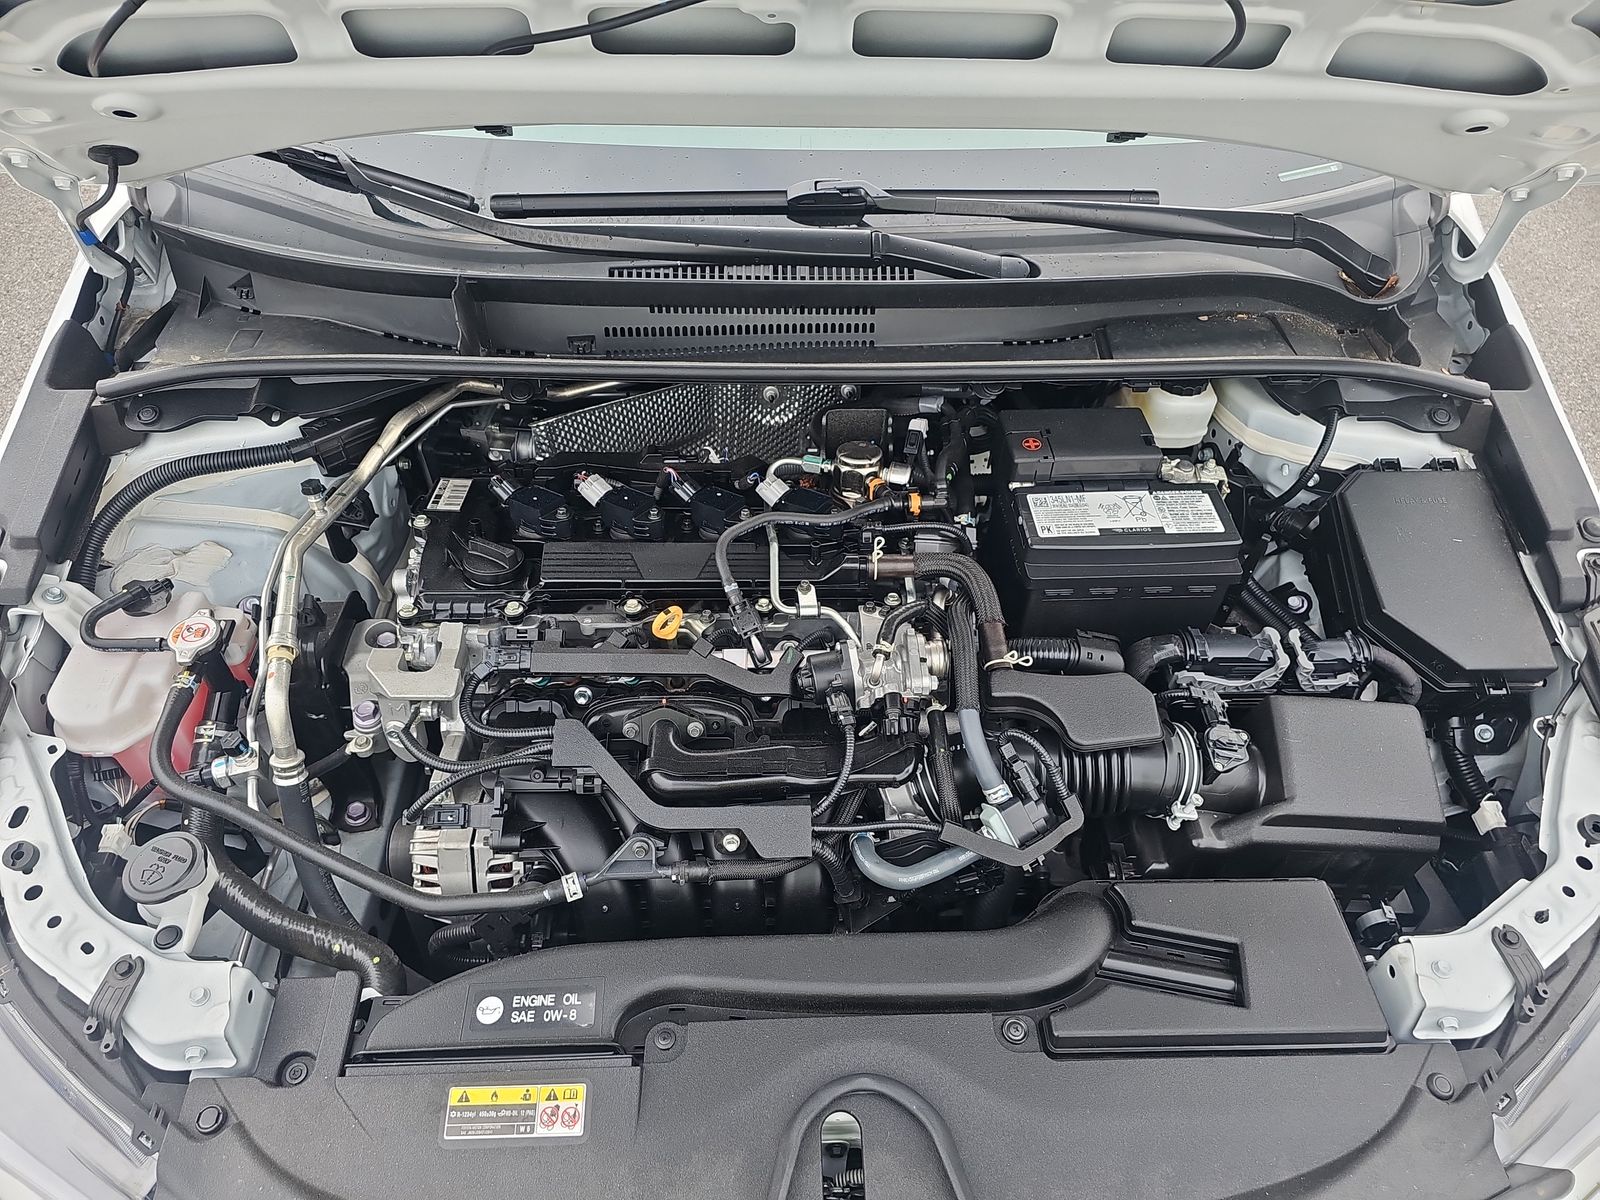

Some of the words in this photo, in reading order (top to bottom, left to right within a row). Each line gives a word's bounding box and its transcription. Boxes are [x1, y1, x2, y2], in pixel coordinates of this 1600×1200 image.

[1041, 525, 1053, 534] PK
[512, 994, 556, 1008] ENGINE
[562, 993, 582, 1006] OIL
[510, 1010, 536, 1023] SAE
[543, 1009, 577, 1022] 0W-8
